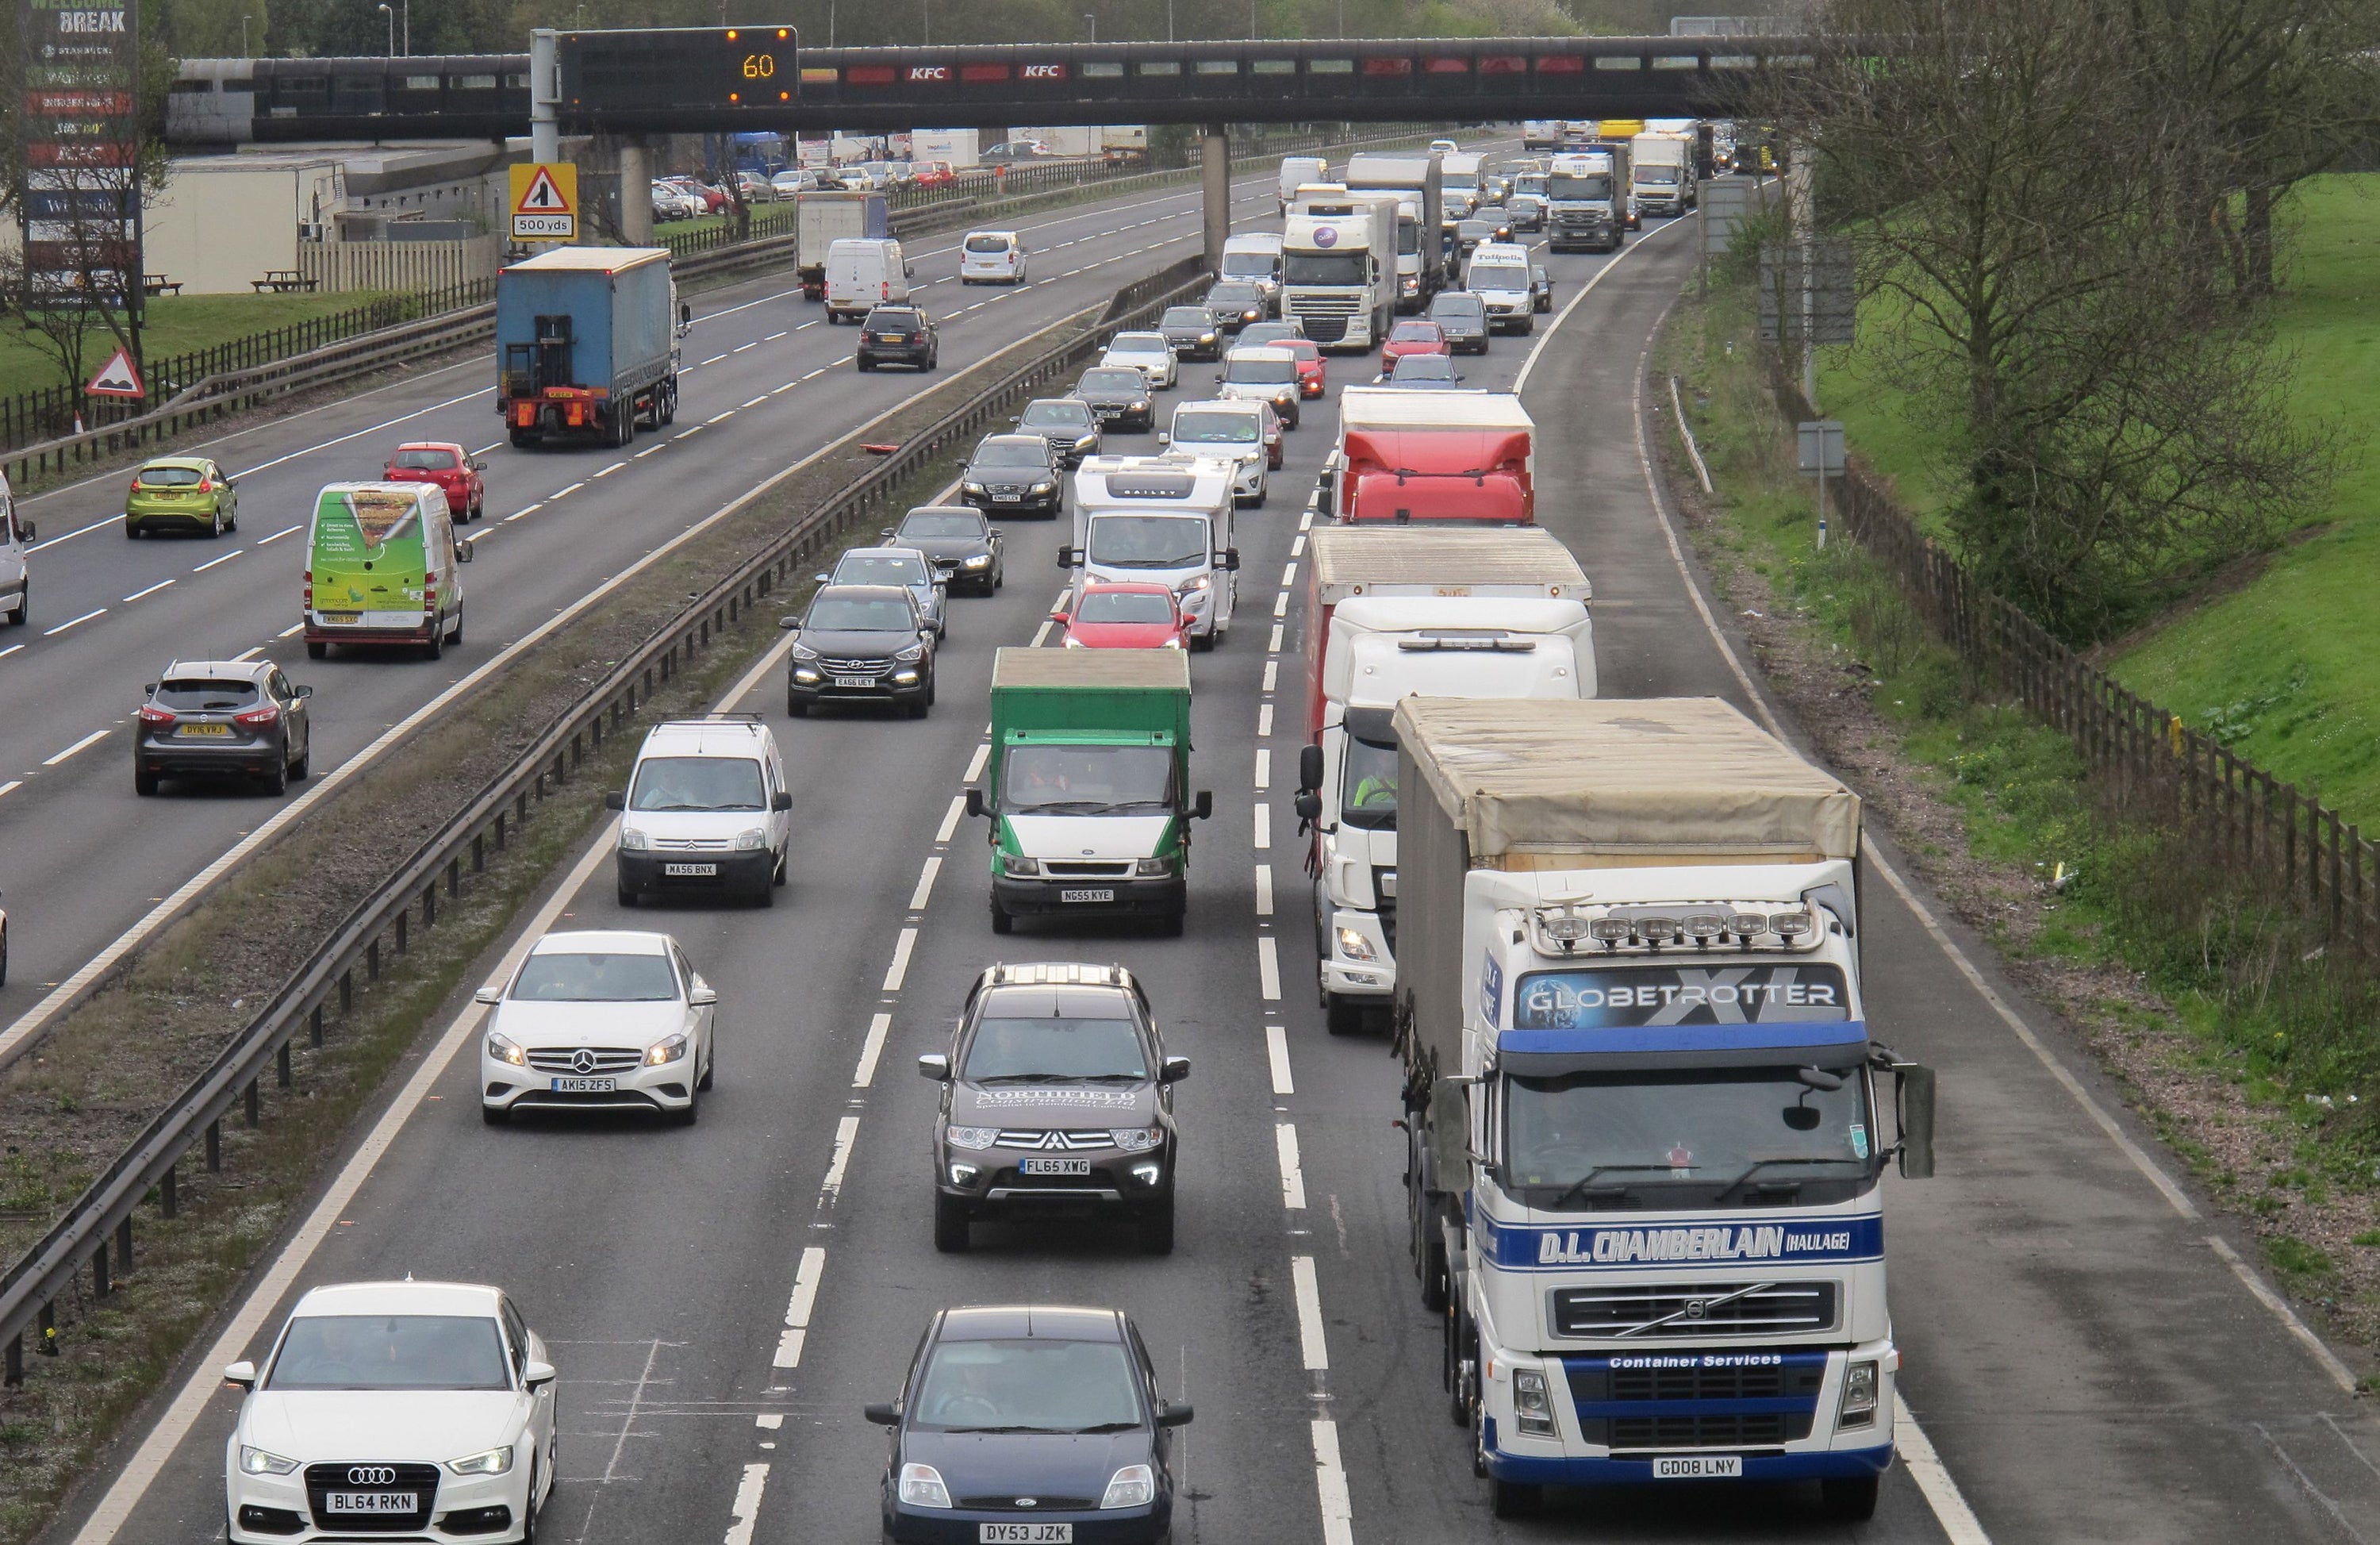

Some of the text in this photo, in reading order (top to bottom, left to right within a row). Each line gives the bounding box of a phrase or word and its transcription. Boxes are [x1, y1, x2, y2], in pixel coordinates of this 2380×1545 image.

[60, 11, 125, 33] BREAK
[743, 55, 774, 77] 60
[1024, 65, 1059, 77] KFC
[910, 67, 946, 79] KFC
[520, 220, 567, 232] 500 yds
[206, 725, 222, 734] VRJ
[695, 865, 712, 874] BNX
[1065, 890, 1110, 900] NG55 KYE
[1528, 984, 1837, 1010] GLOBETROTTER
[562, 1080, 612, 1090] AK15 ZFS
[1027, 1161, 1088, 1172] FL65 XWG
[1539, 1226, 1850, 1263] D.L. CHAMBERLAIN (HAULAGE)
[1610, 1355, 1782, 1368] Container Services
[1660, 1459, 1736, 1475] GD08 LNY
[334, 1494, 412, 1509] BL64 RKN
[986, 1526, 1065, 1540] DY53 JZK
